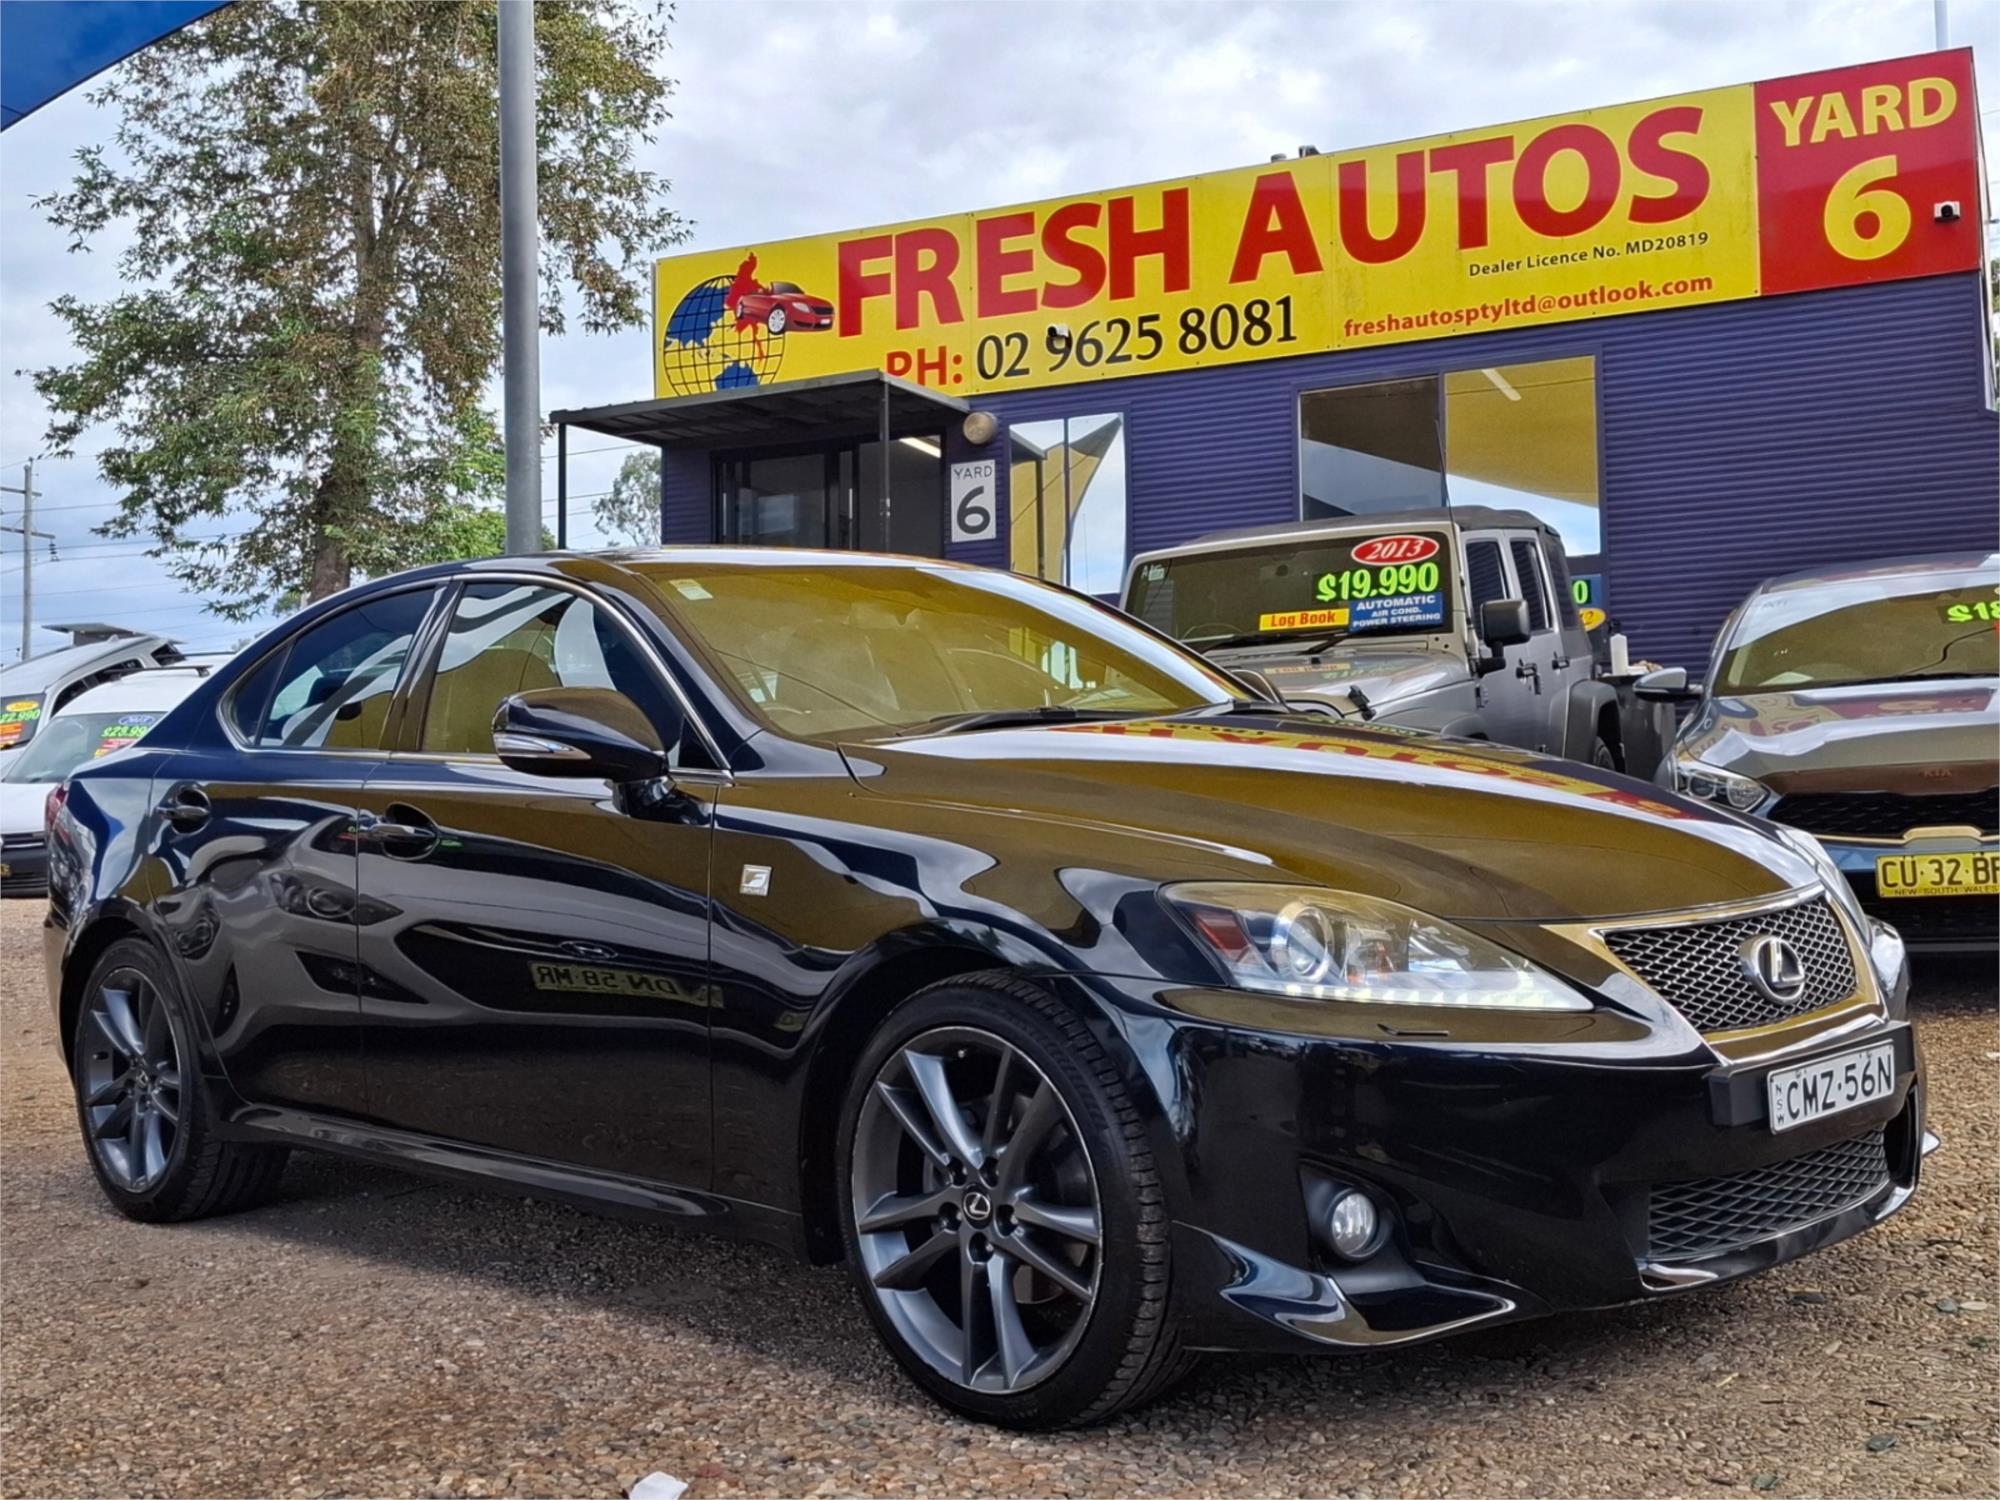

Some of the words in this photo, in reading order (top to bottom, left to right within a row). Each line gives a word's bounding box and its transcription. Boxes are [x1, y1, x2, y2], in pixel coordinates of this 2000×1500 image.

[1769, 77, 1957, 147] YARD
[838, 187, 1190, 337] FRESH
[1229, 106, 1710, 284] AUTOS
[1823, 154, 1911, 260] 6
[1469, 258, 1521, 276] Dealer
[1527, 250, 1588, 268] Licence
[1593, 246, 1620, 259] No.
[1626, 232, 1709, 255] MD20819
[1344, 276, 1713, 337] freshautosptyltd@outlook.com
[887, 346, 962, 386] PH:
[977, 332, 1030, 380] 02
[1046, 314, 1163, 372] 9625
[1178, 295, 1297, 354] 8081
[954, 465, 992, 480] YARD
[957, 486, 991, 534] 6
[1365, 540, 1425, 560] 2013
[1356, 594, 1436, 611] AUTOMATIC
[1371, 609, 1389, 618] AIR
[1391, 606, 1422, 616] COND.
[1271, 614, 1296, 628] Log
[1300, 610, 1336, 625] Book
[1353, 617, 1388, 628] POWER
[1389, 612, 1441, 624] STEERING
[1894, 888, 1917, 896] NEW
[1923, 887, 1958, 895] SOUTH
[1964, 885, 1999, 894] WALES
